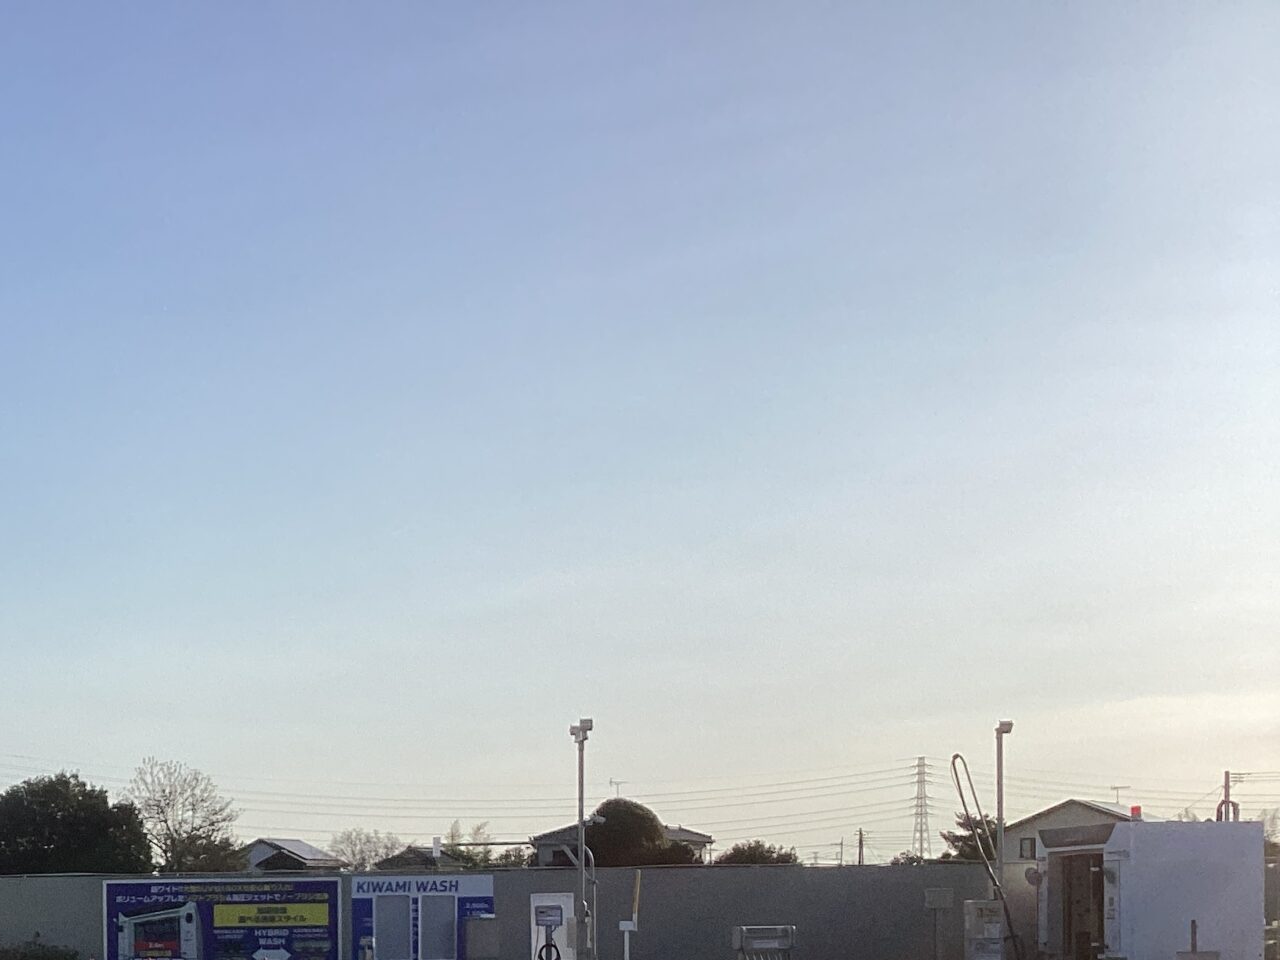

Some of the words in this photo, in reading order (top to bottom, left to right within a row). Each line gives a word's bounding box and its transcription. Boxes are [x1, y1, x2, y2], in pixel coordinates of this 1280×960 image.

[356, 880, 411, 893] KIWAMI
[415, 879, 459, 892] WASH
[254, 928, 290, 938] HYBRID
[258, 937, 286, 946] WASH
